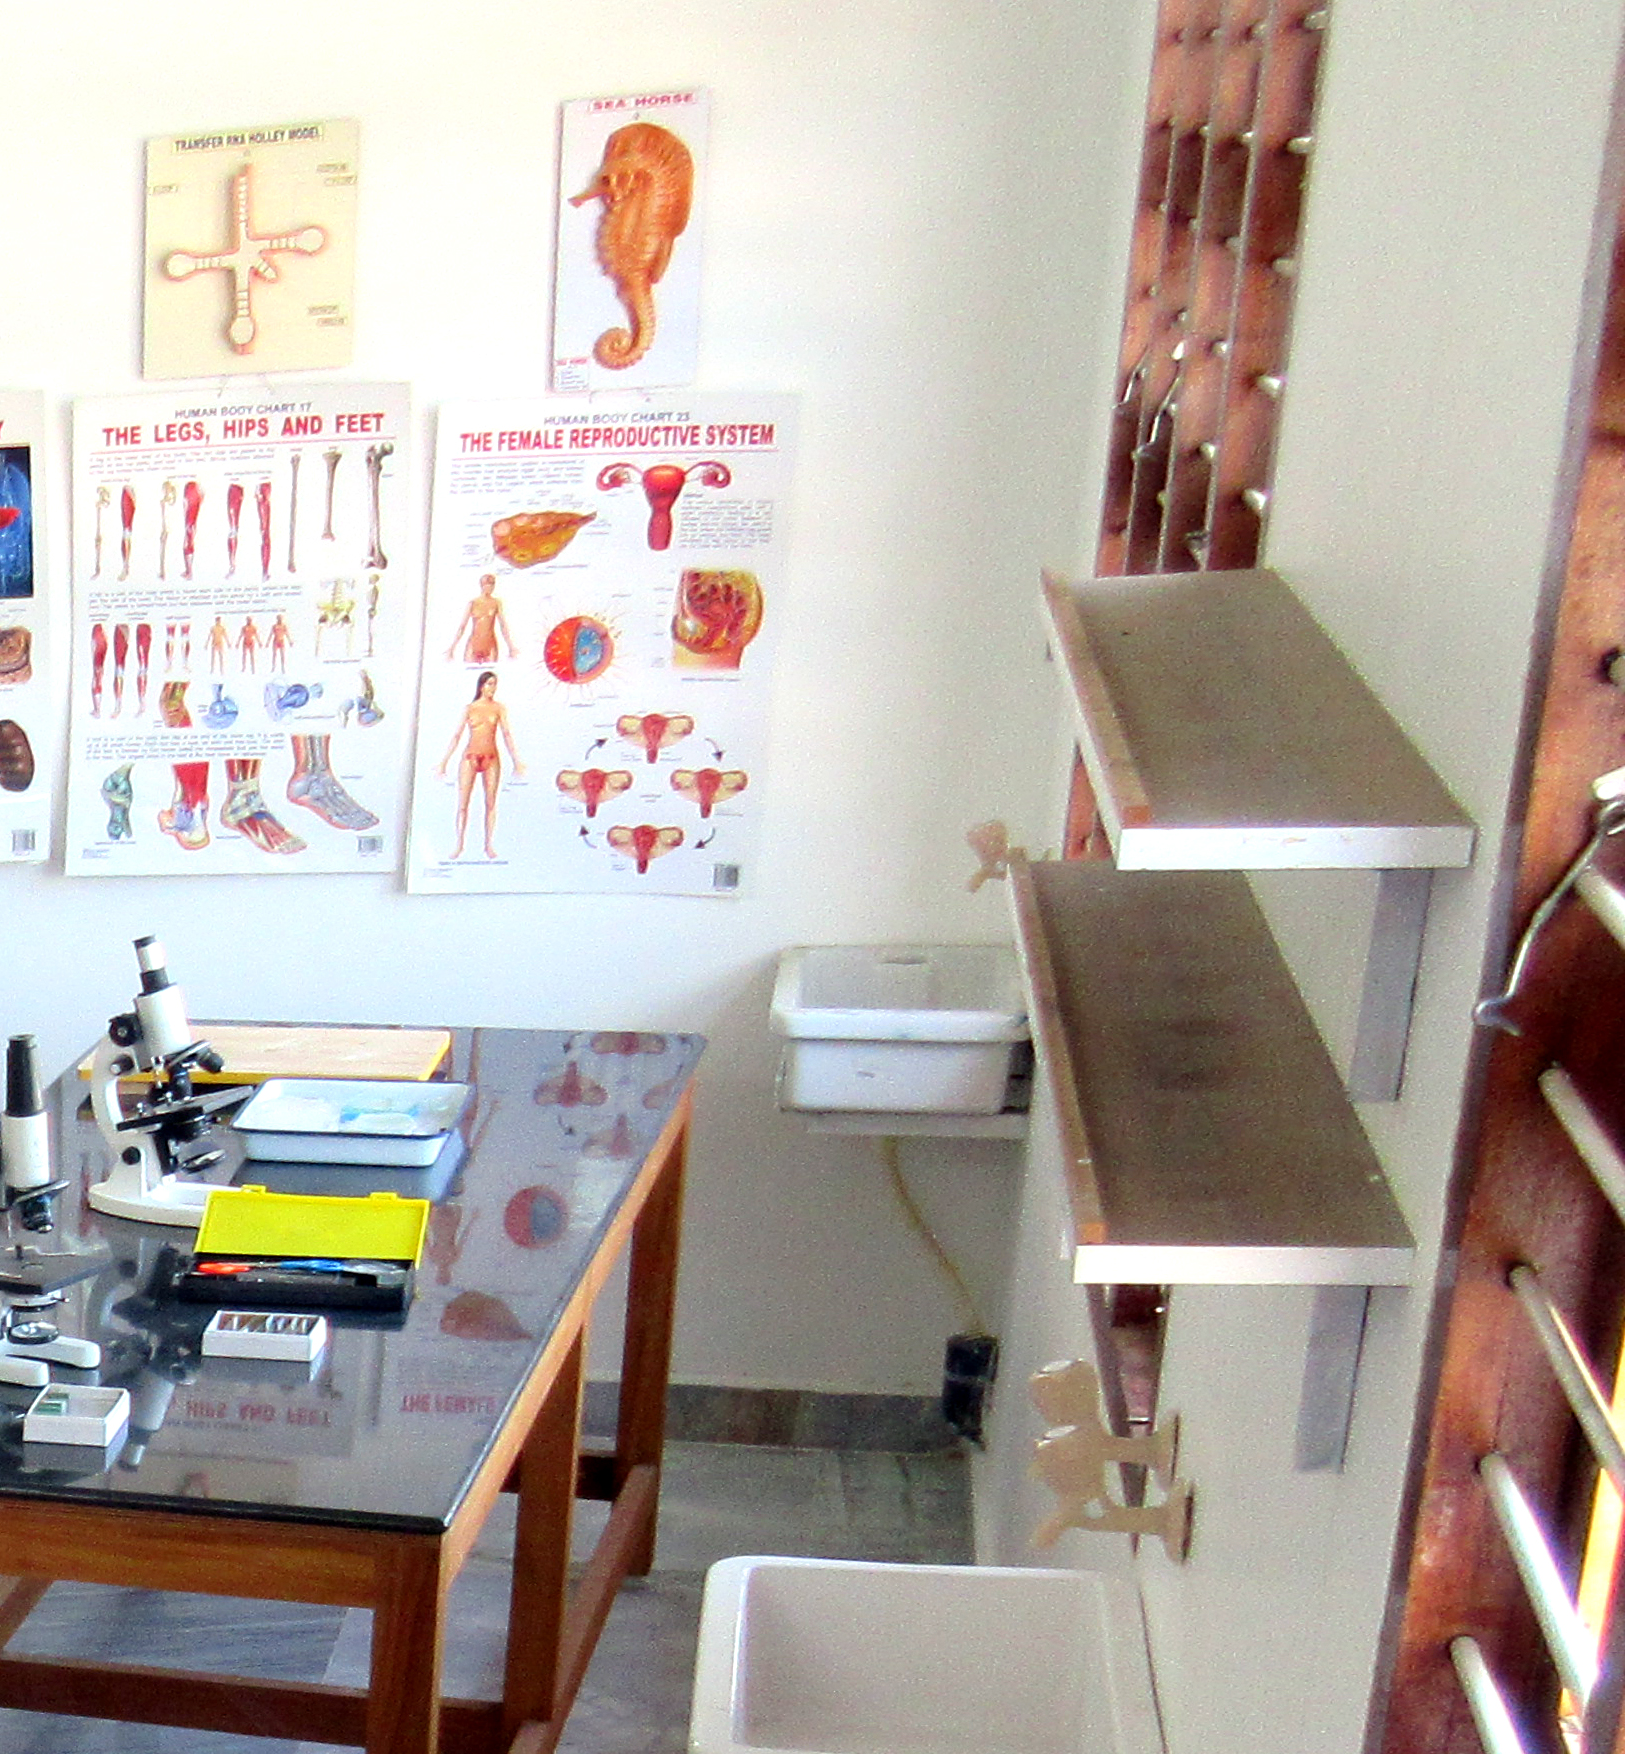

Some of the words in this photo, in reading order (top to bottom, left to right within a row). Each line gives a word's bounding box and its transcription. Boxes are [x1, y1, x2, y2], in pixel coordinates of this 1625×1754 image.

[174, 407, 218, 419] HUMAN
[221, 405, 254, 417] BODY
[256, 403, 297, 415] CHART
[543, 414, 589, 426] HUMAN
[592, 413, 628, 424] BODY
[631, 411, 674, 423] CHART
[102, 426, 141, 447] THE
[154, 421, 211, 444] LEGS,
[223, 417, 269, 439] HIPS
[281, 414, 323, 436] AND
[335, 412, 385, 434] FEET
[460, 431, 493, 453] THE
[497, 429, 564, 452] FEMALE
[569, 425, 701, 450] REPRODUCTIVE
[705, 423, 774, 446] SYSTEM
